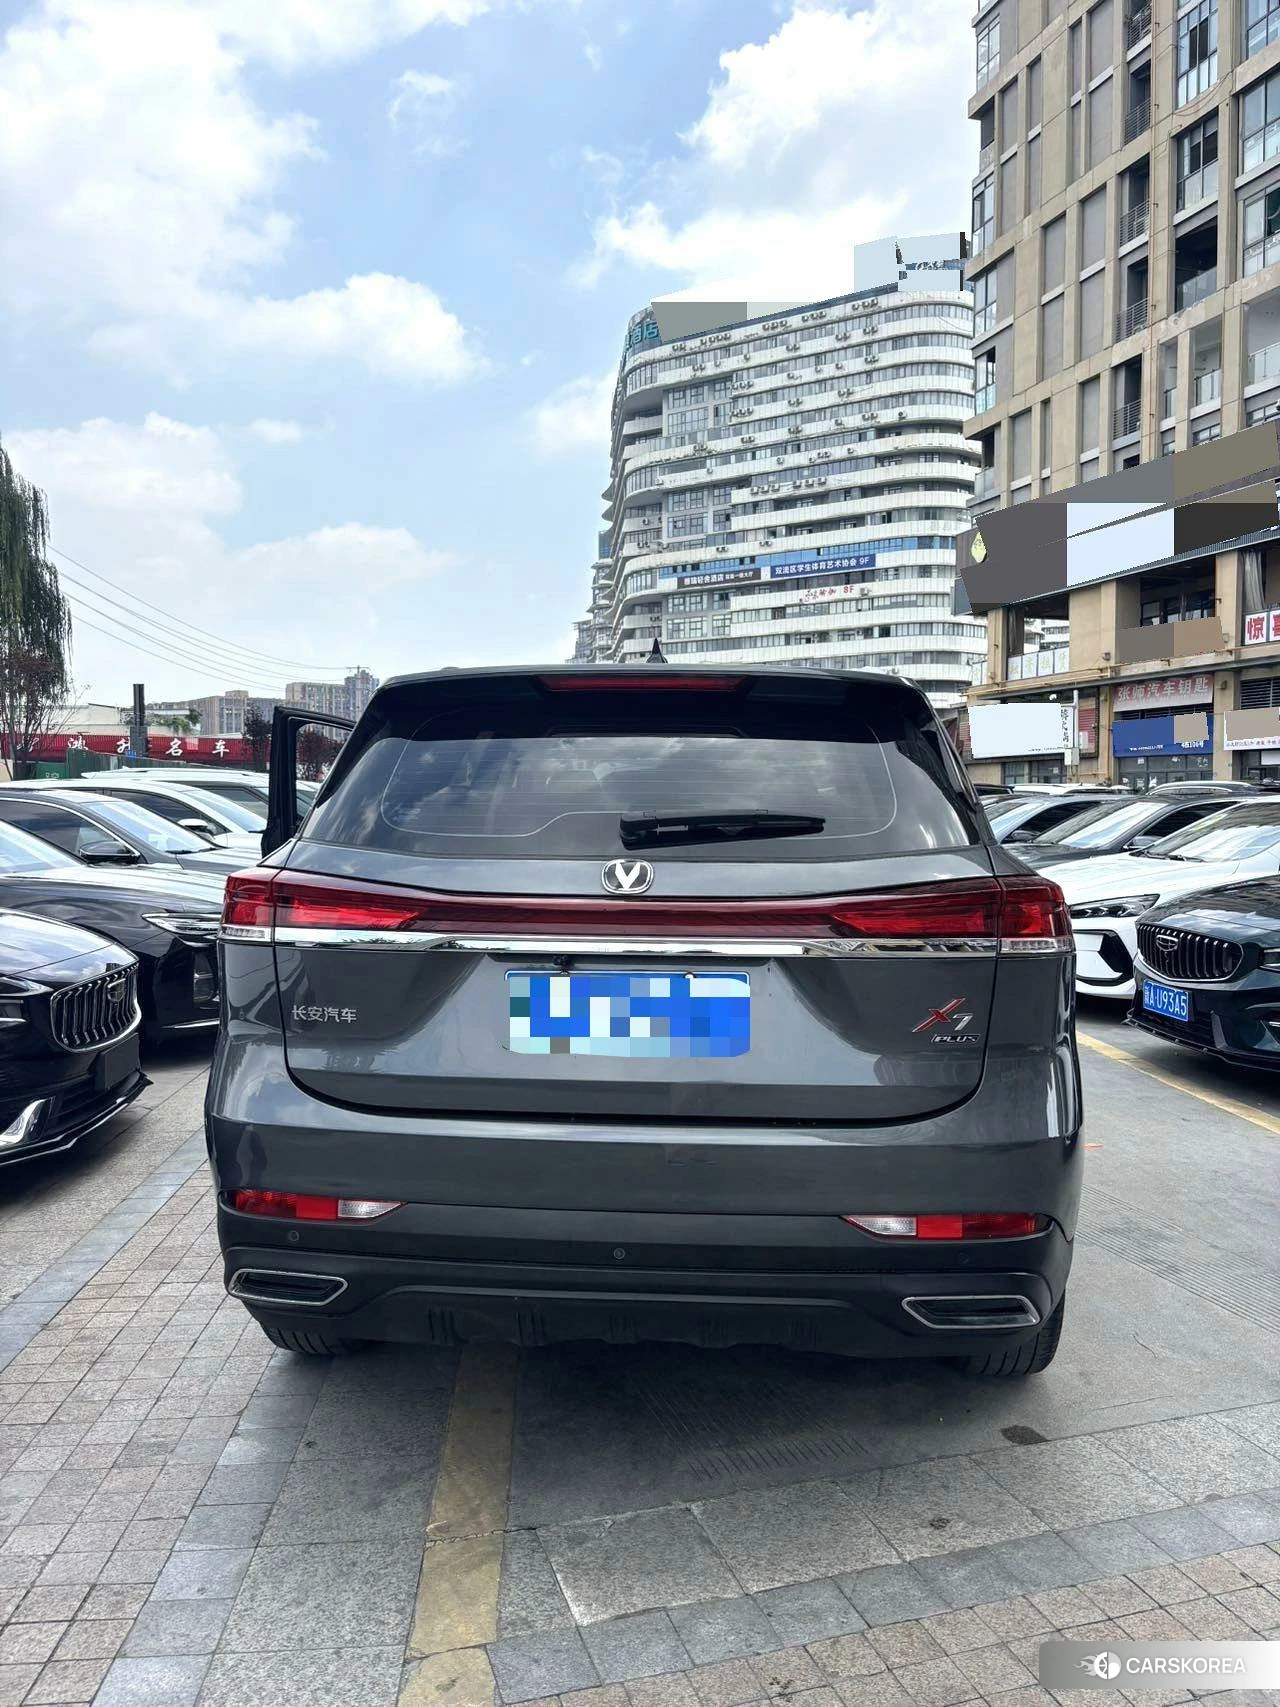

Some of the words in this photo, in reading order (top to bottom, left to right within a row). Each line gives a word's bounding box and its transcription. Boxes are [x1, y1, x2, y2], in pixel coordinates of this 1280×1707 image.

[775, 558, 857, 576] 双流区学生体育艺术协会
[860, 556, 870, 566] 9F
[843, 585, 855, 594] 8F
[1118, 677, 1209, 701] 张师汽车钥匙
[292, 1004, 357, 1023] 长安汽车
[912, 998, 974, 1032] X7
[933, 1034, 978, 1043] PLUS
